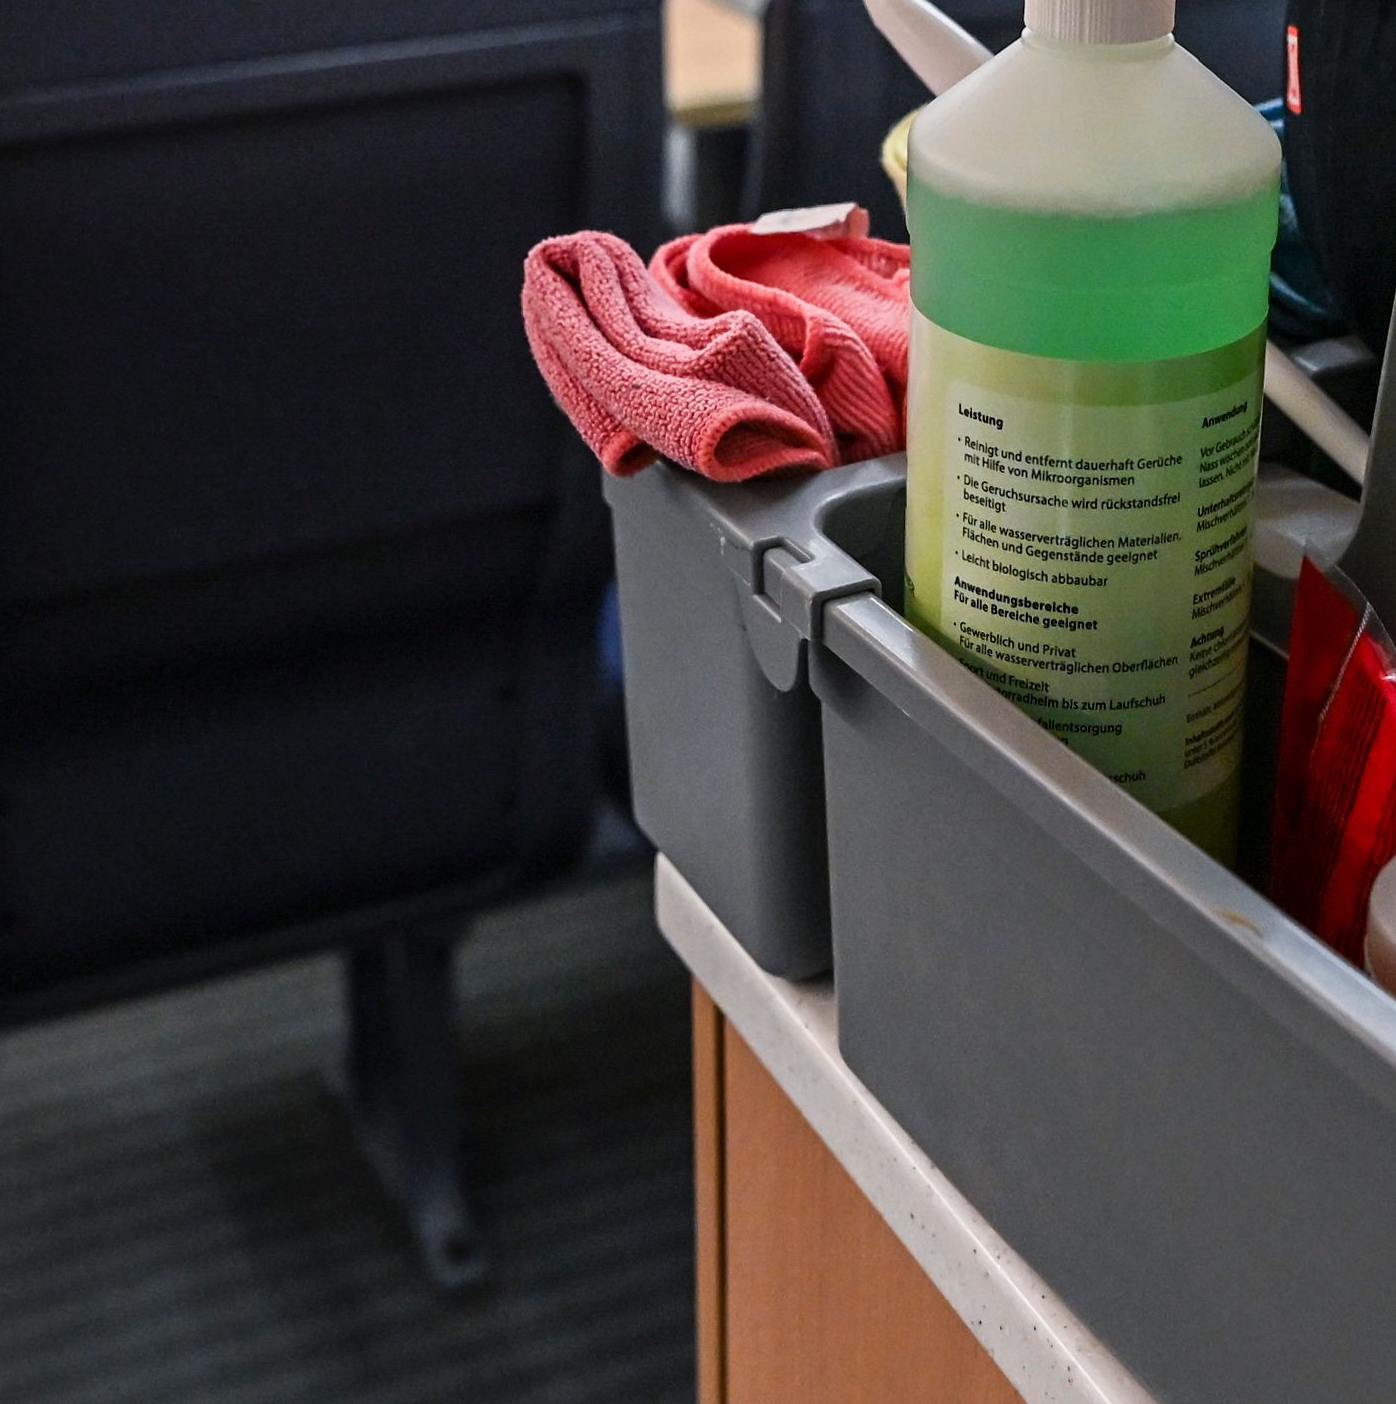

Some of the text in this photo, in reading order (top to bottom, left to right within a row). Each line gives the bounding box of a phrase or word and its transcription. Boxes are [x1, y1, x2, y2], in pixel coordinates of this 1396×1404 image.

[958, 403, 1003, 430] Leistung
[964, 436, 1183, 471] Reinigt und entfernt dauerhaft Gerüche
[964, 453, 1135, 488] mit Hilfe von Mikroorganismen
[963, 474, 979, 489] Die
[981, 481, 1069, 508] Geruchsursache
[1071, 498, 1098, 510] wird
[1101, 492, 1181, 510] rückstandsfrei
[963, 488, 1006, 513] beseitigt
[962, 512, 1182, 550] Für alle wasserverträglichen Materialien,
[962, 526, 1158, 566] Flächen und Gegenstände geeignet
[961, 549, 1108, 586] Leicht biologisch abbaubar
[954, 576, 1079, 614] Anwendungsbereiche
[954, 590, 1098, 632] Für alle Bereiche geeignet
[959, 621, 1076, 658] Gewerblich und Privat
[959, 635, 1178, 675] Für alle wasserverträglichen Oberflächen
[986, 670, 1006, 684] und
[1009, 675, 1050, 693] Freizeit
[997, 688, 1165, 711] orradhelm bis zum Laufschuh
[1037, 717, 1123, 735] fallentsorgung
